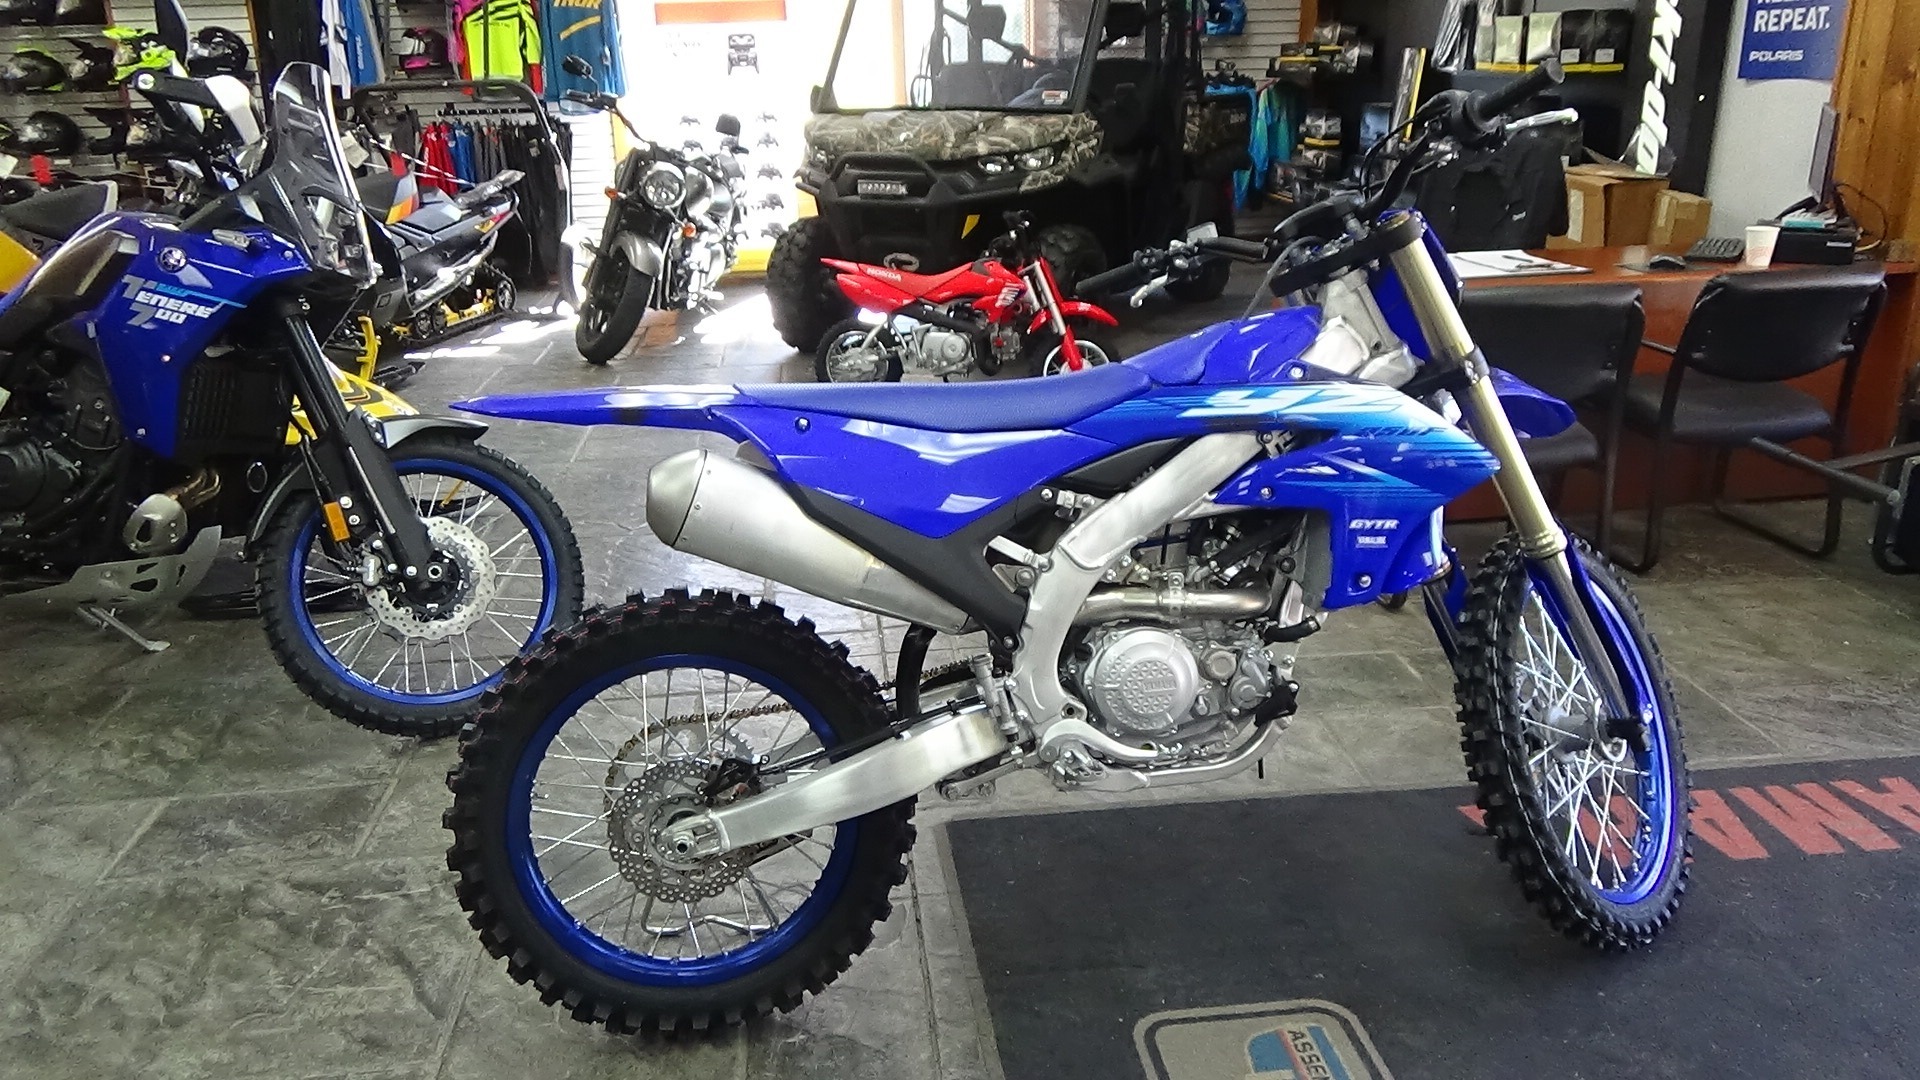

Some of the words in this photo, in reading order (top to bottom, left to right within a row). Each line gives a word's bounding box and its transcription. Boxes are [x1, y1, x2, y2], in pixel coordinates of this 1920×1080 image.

[1753, 5, 1831, 33] REPEAT.
[1748, 49, 1804, 62] POLARIS
[866, 266, 902, 283] HONDA
[126, 302, 188, 327] 700
[1177, 389, 1402, 417] YZ
[1348, 518, 1400, 531] GYTR
